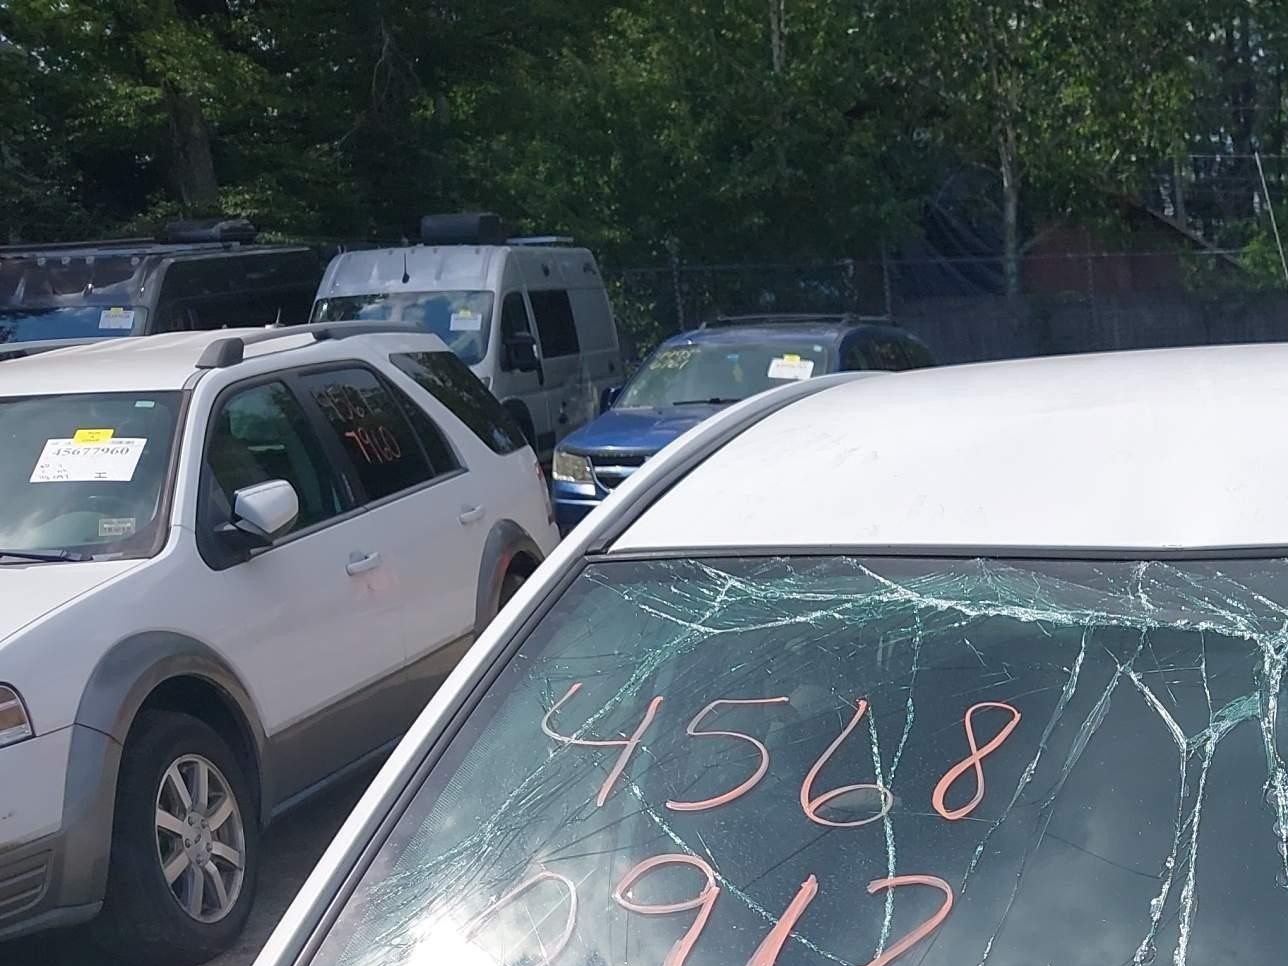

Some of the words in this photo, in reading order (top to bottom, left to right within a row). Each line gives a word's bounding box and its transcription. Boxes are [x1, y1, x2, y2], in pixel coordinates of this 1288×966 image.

[52, 447, 130, 456] 45677960
[345, 426, 401, 464] 7960
[541, 682, 1022, 828] 4568
